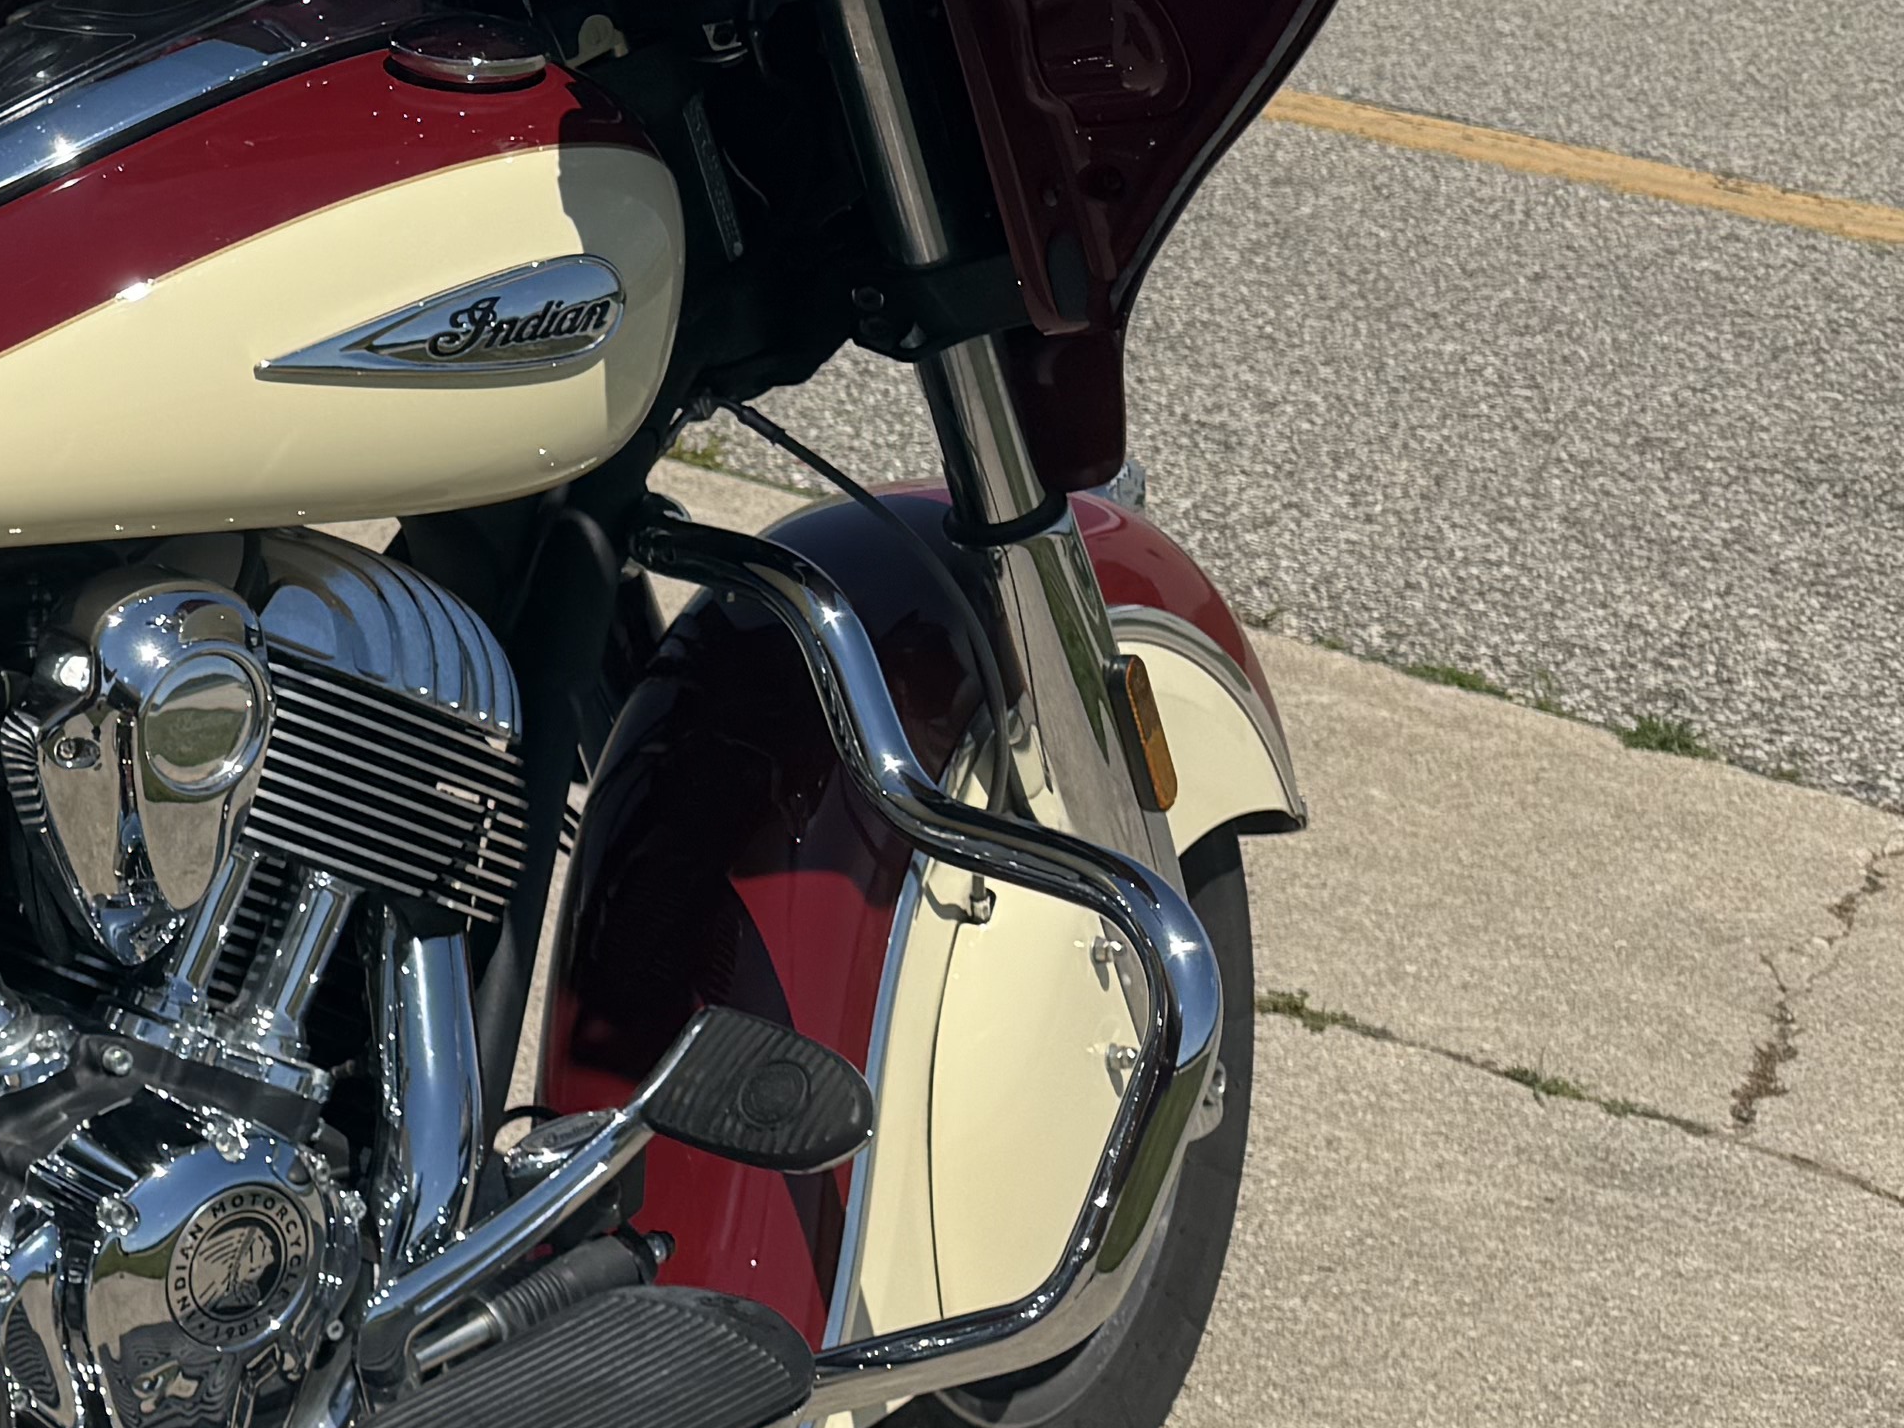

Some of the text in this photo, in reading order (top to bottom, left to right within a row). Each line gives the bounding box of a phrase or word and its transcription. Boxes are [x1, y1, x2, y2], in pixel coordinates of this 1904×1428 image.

[425, 295, 613, 360] Indian
[174, 1193, 303, 1321] INDIAN MOTORCYCLE
[213, 1317, 261, 1340] 1901
